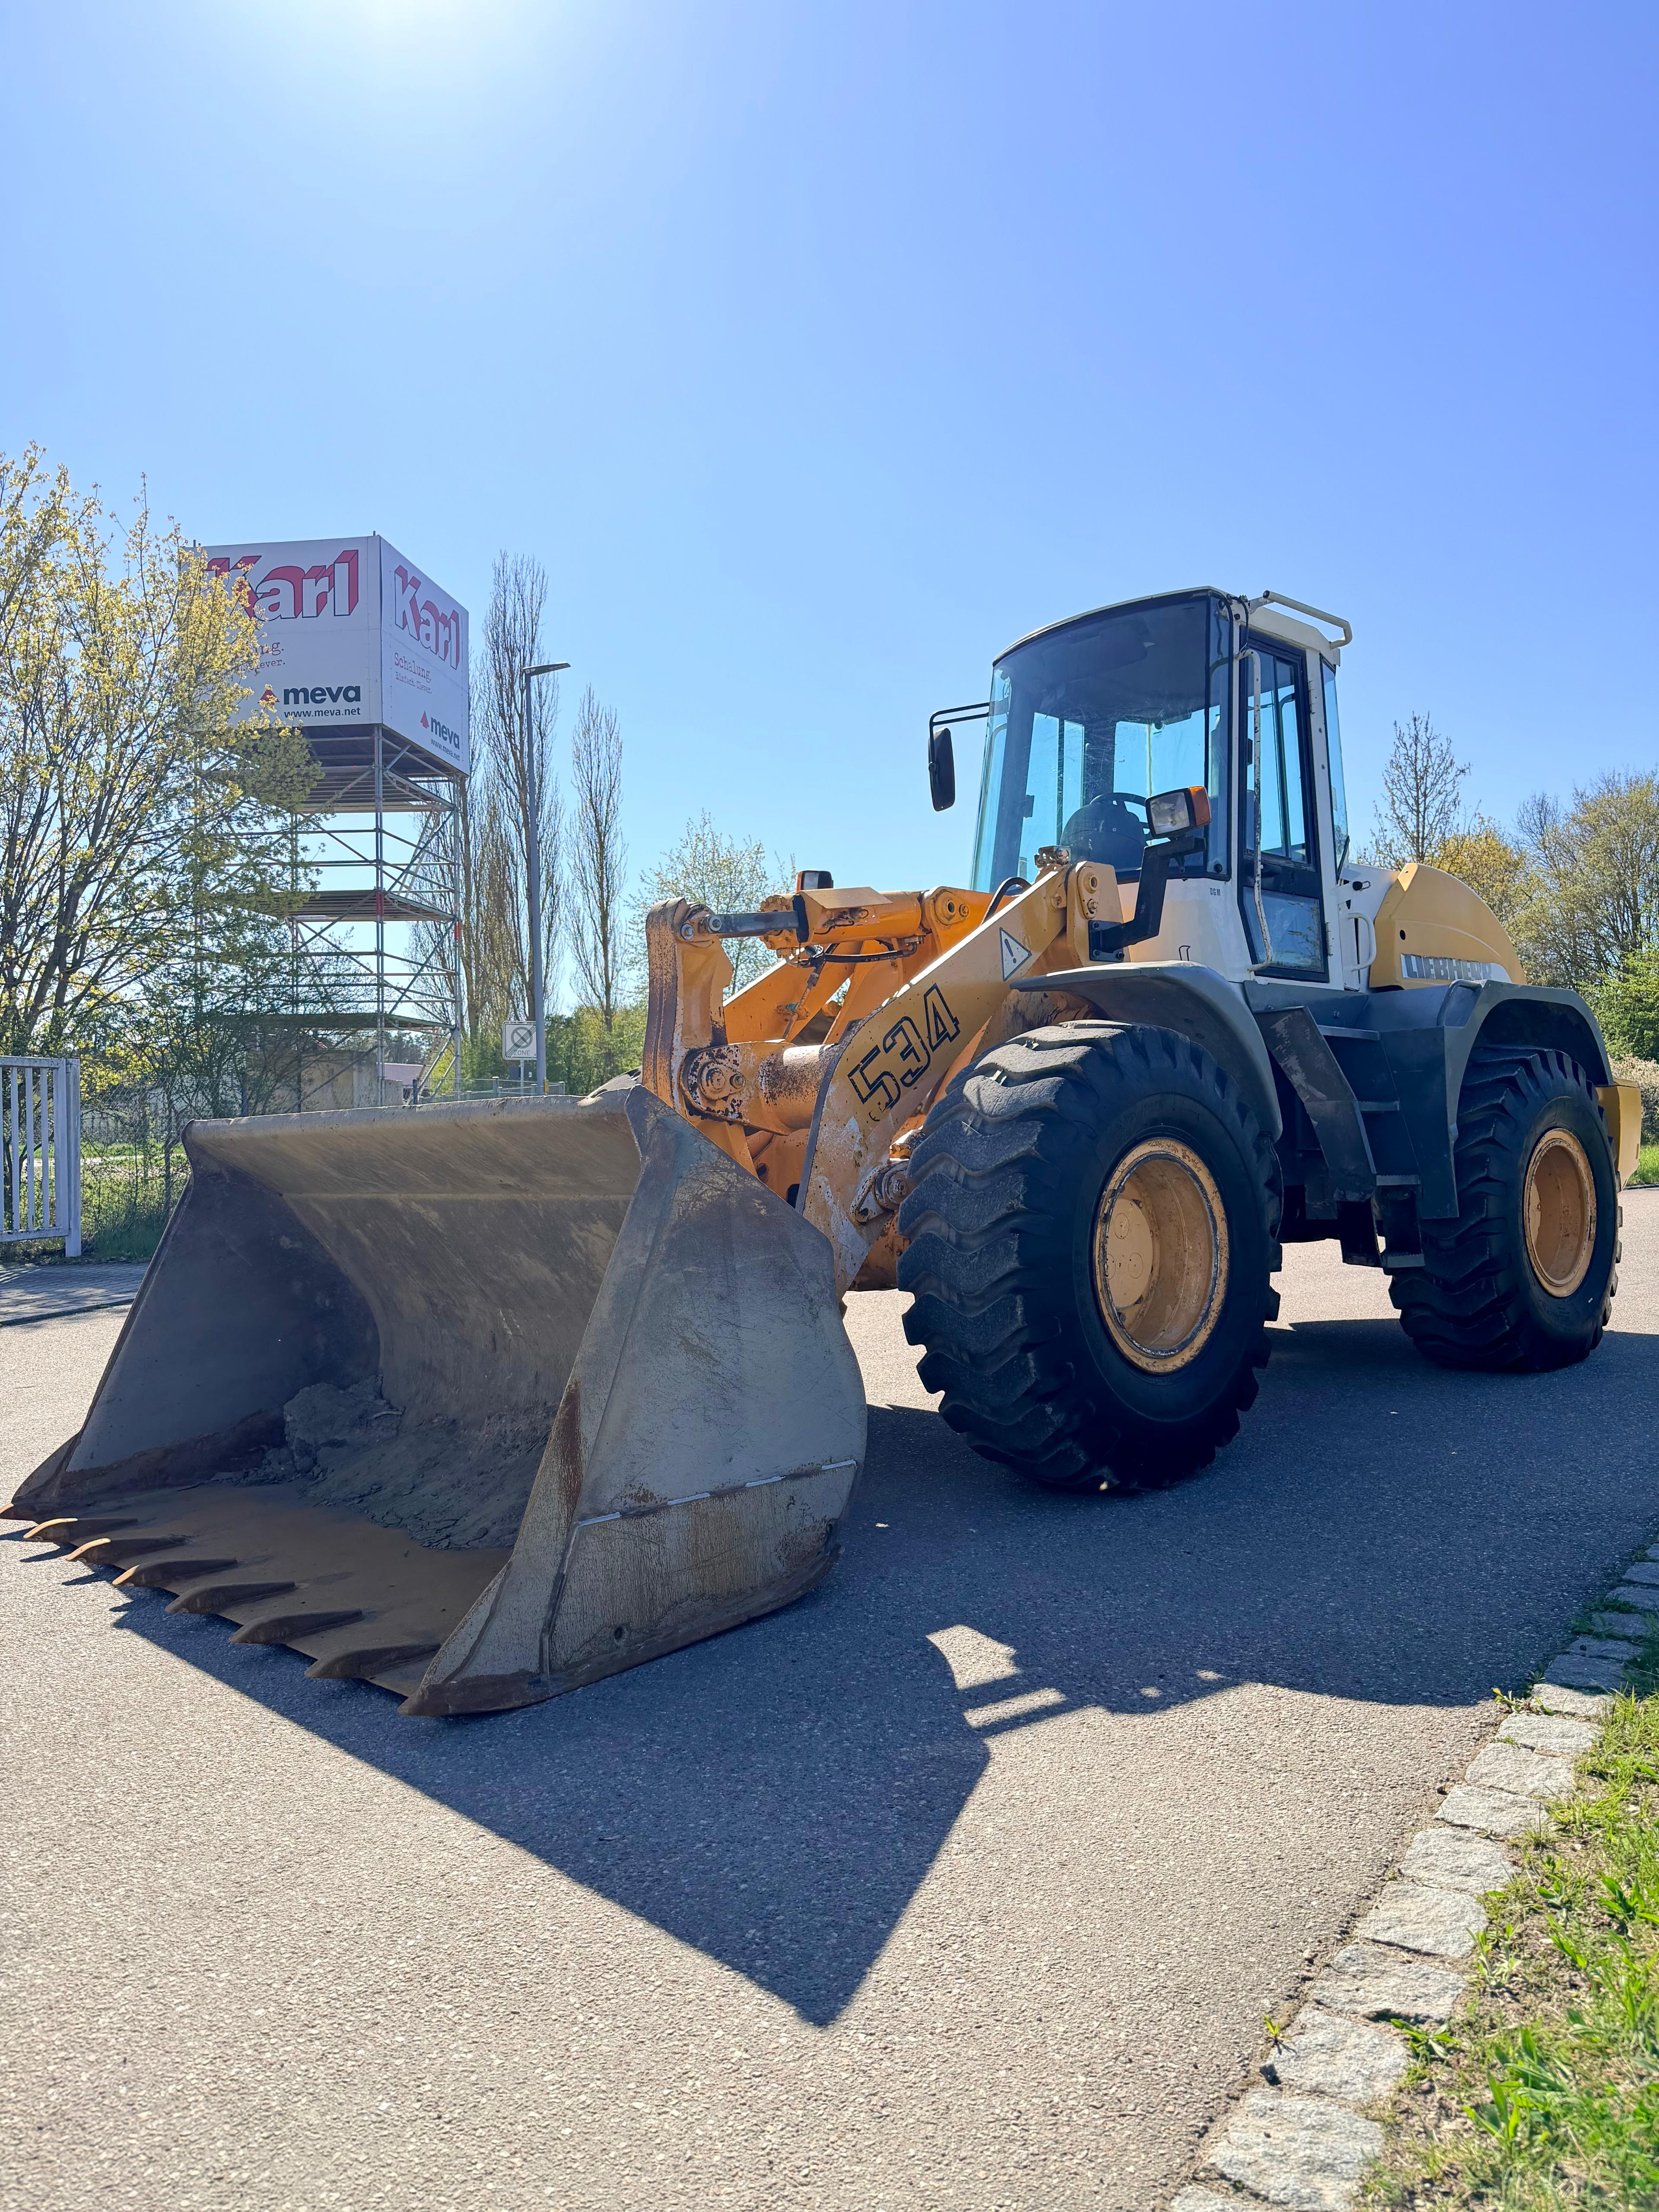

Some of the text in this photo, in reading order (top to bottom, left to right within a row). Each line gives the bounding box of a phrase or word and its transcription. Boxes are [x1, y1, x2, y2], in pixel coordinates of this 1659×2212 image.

[394, 565, 460, 670] Karl
[394, 652, 432, 683] Schalung.
[284, 686, 361, 705] meva
[284, 707, 361, 718] www.meva.net
[431, 717, 460, 750] meva
[431, 738, 460, 761] www.meva.net
[1404, 953, 1492, 980] LIEBHERR
[847, 983, 961, 1122] 534
